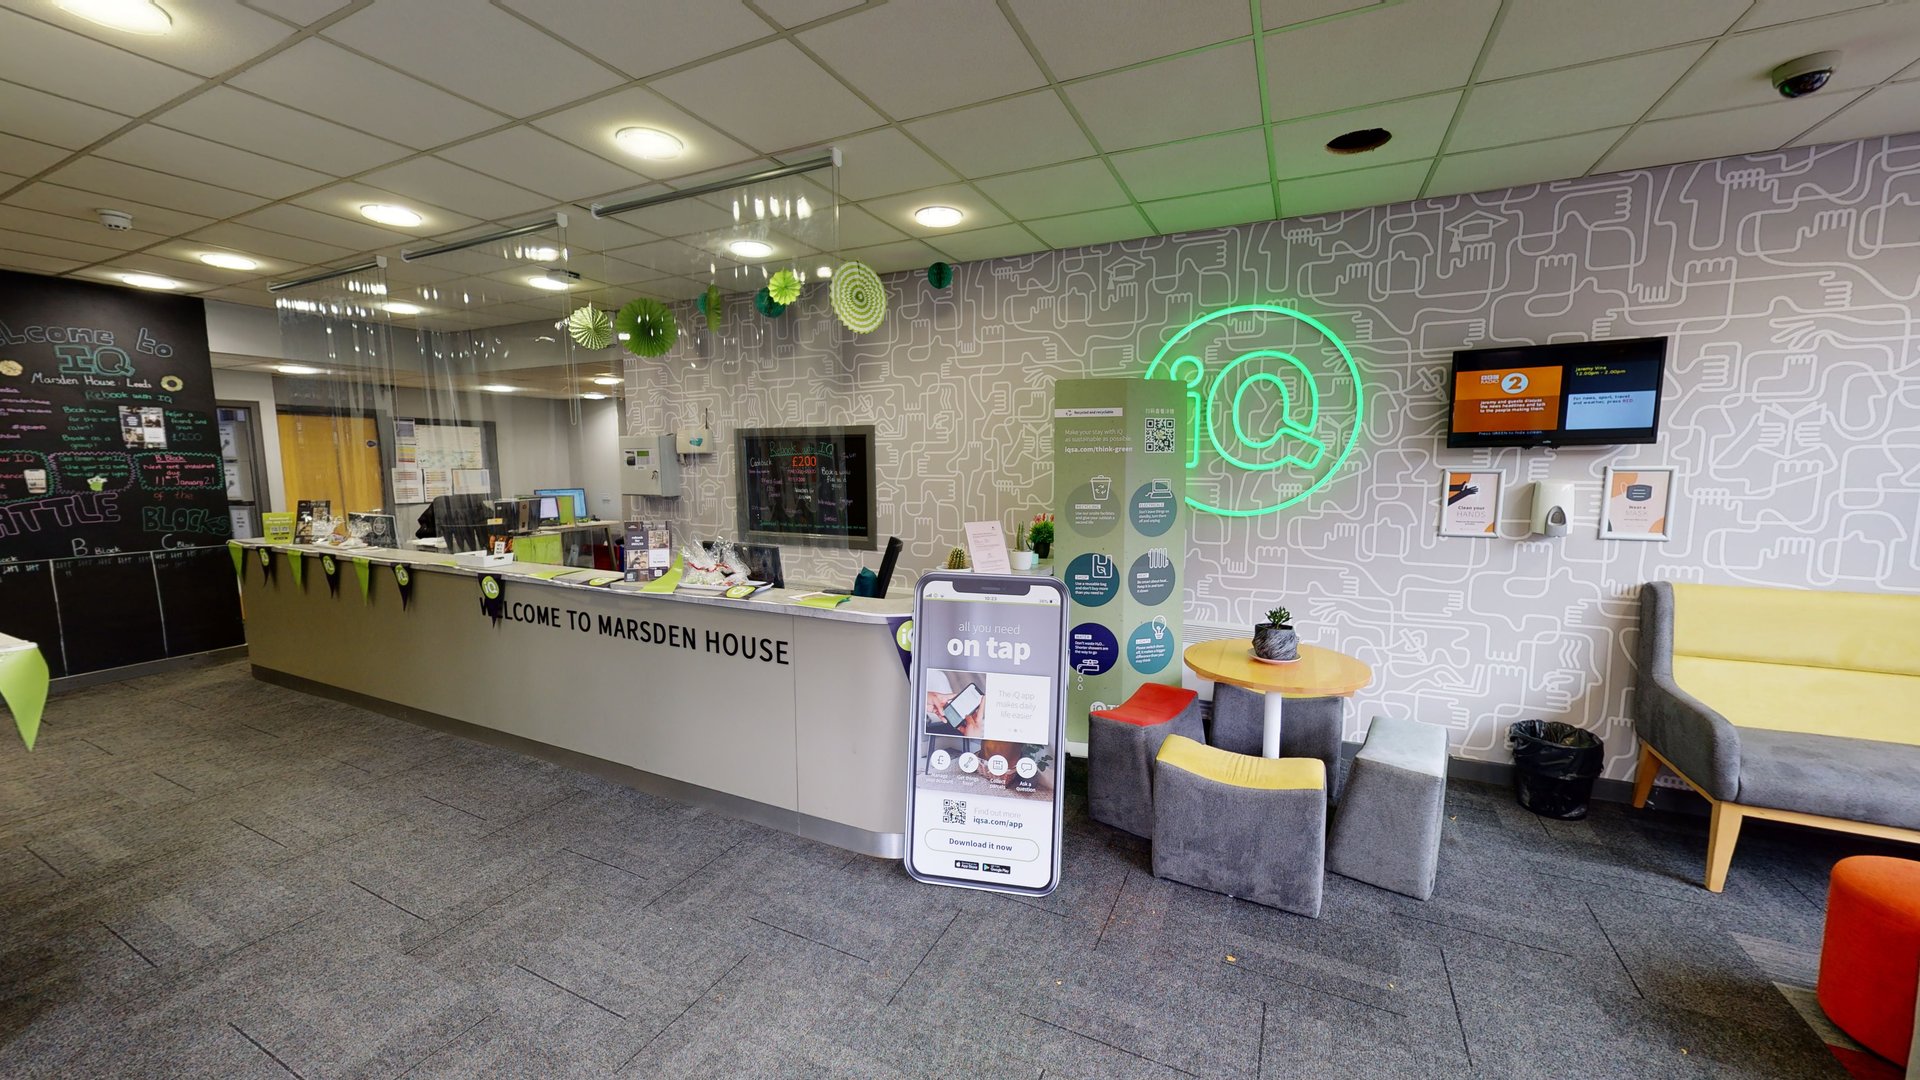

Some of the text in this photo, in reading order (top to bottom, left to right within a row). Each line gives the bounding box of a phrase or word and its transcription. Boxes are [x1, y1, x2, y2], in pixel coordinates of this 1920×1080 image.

[54, 345, 135, 377] IQ
[31, 372, 152, 389] Marsden House Leeds
[1507, 376, 1522, 390] 2
[792, 456, 817, 467] £200
[72, 538, 121, 558] B Block
[161, 533, 178, 551] C
[484, 581, 499, 596] iQ
[480, 597, 790, 665] WLCOME TO MARSDEN HOUSE
[958, 621, 1020, 636] all you need
[947, 636, 1031, 666] on tap
[998, 689, 1011, 698] The
[1022, 693, 1035, 703] app
[996, 701, 1036, 714] makes daily
[1000, 710, 1032, 721] life easier
[1016, 785, 1036, 793] question
[974, 807, 1021, 819] Find out more
[973, 815, 1023, 829] iqsa.com/app
[949, 837, 1013, 852] Download it now
